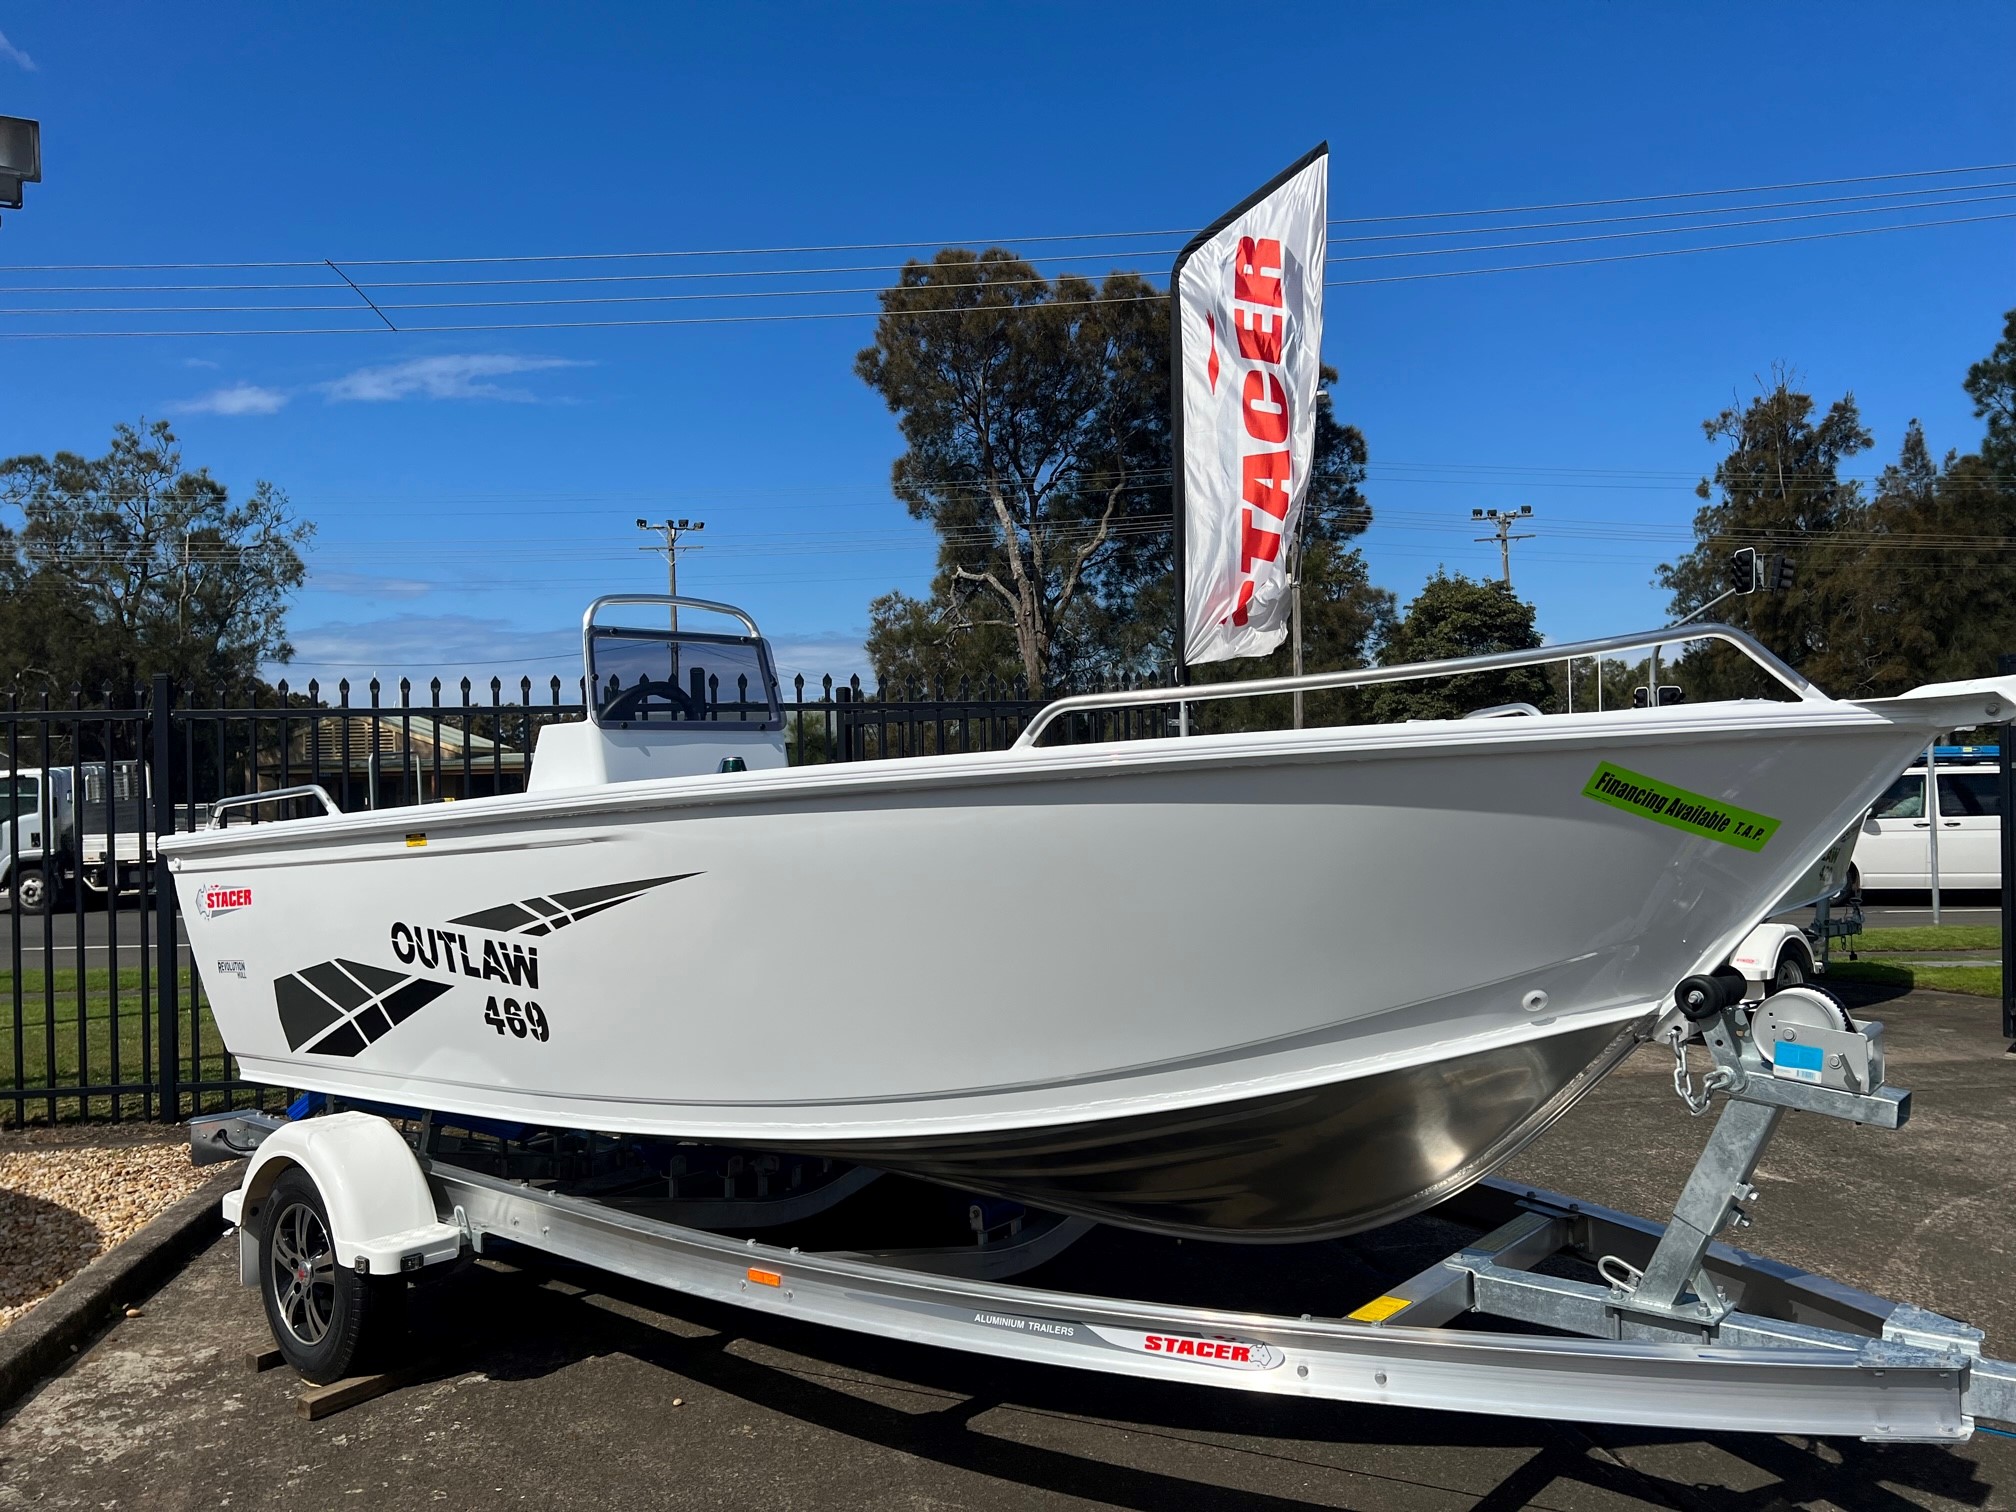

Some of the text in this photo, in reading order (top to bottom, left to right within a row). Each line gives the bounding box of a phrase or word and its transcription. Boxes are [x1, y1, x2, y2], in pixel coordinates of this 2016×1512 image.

[1595, 771, 1765, 841] Financing Available T.A.P.
[207, 889, 252, 909] STACER
[217, 961, 246, 973] REVOLUTION
[391, 921, 539, 990] OUTLAW
[484, 995, 550, 1043] 469
[974, 1313, 1075, 1337] ALUMINIUM TRAILERS
[1144, 1335, 1251, 1363] STACER
